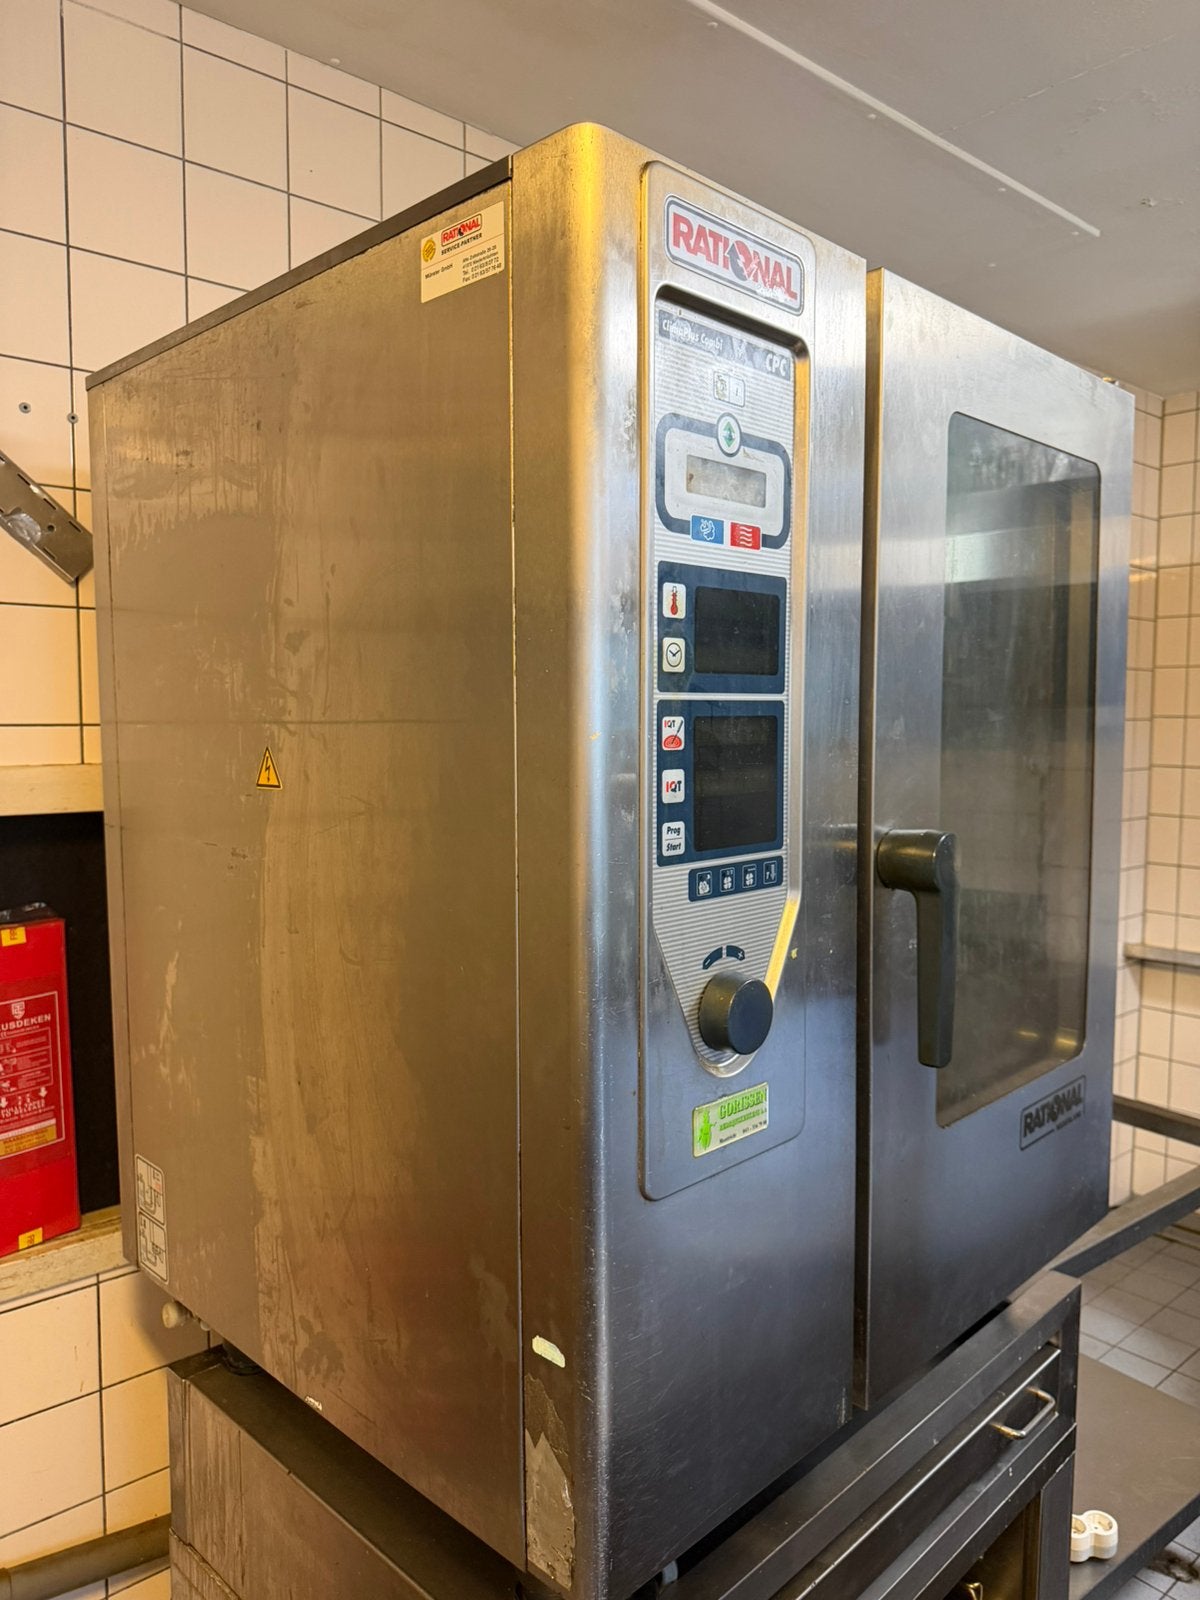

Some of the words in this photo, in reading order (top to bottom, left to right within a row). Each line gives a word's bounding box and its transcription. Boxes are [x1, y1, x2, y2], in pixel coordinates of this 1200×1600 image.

[442, 218, 481, 243] RATIONAL
[441, 243, 460, 255] SERVICE
[460, 232, 482, 247] PARTNER
[672, 211, 798, 300] RATIONAL
[701, 333, 723, 350] Combi
[765, 352, 787, 375] CPC
[664, 720, 676, 729] IQT
[665, 780, 682, 793] IQT
[666, 826, 681, 836] Prog
[665, 842, 682, 852] Start
[0, 1013, 51, 1031] USDEKEN
[1023, 1083, 1083, 1138] RATIONAL
